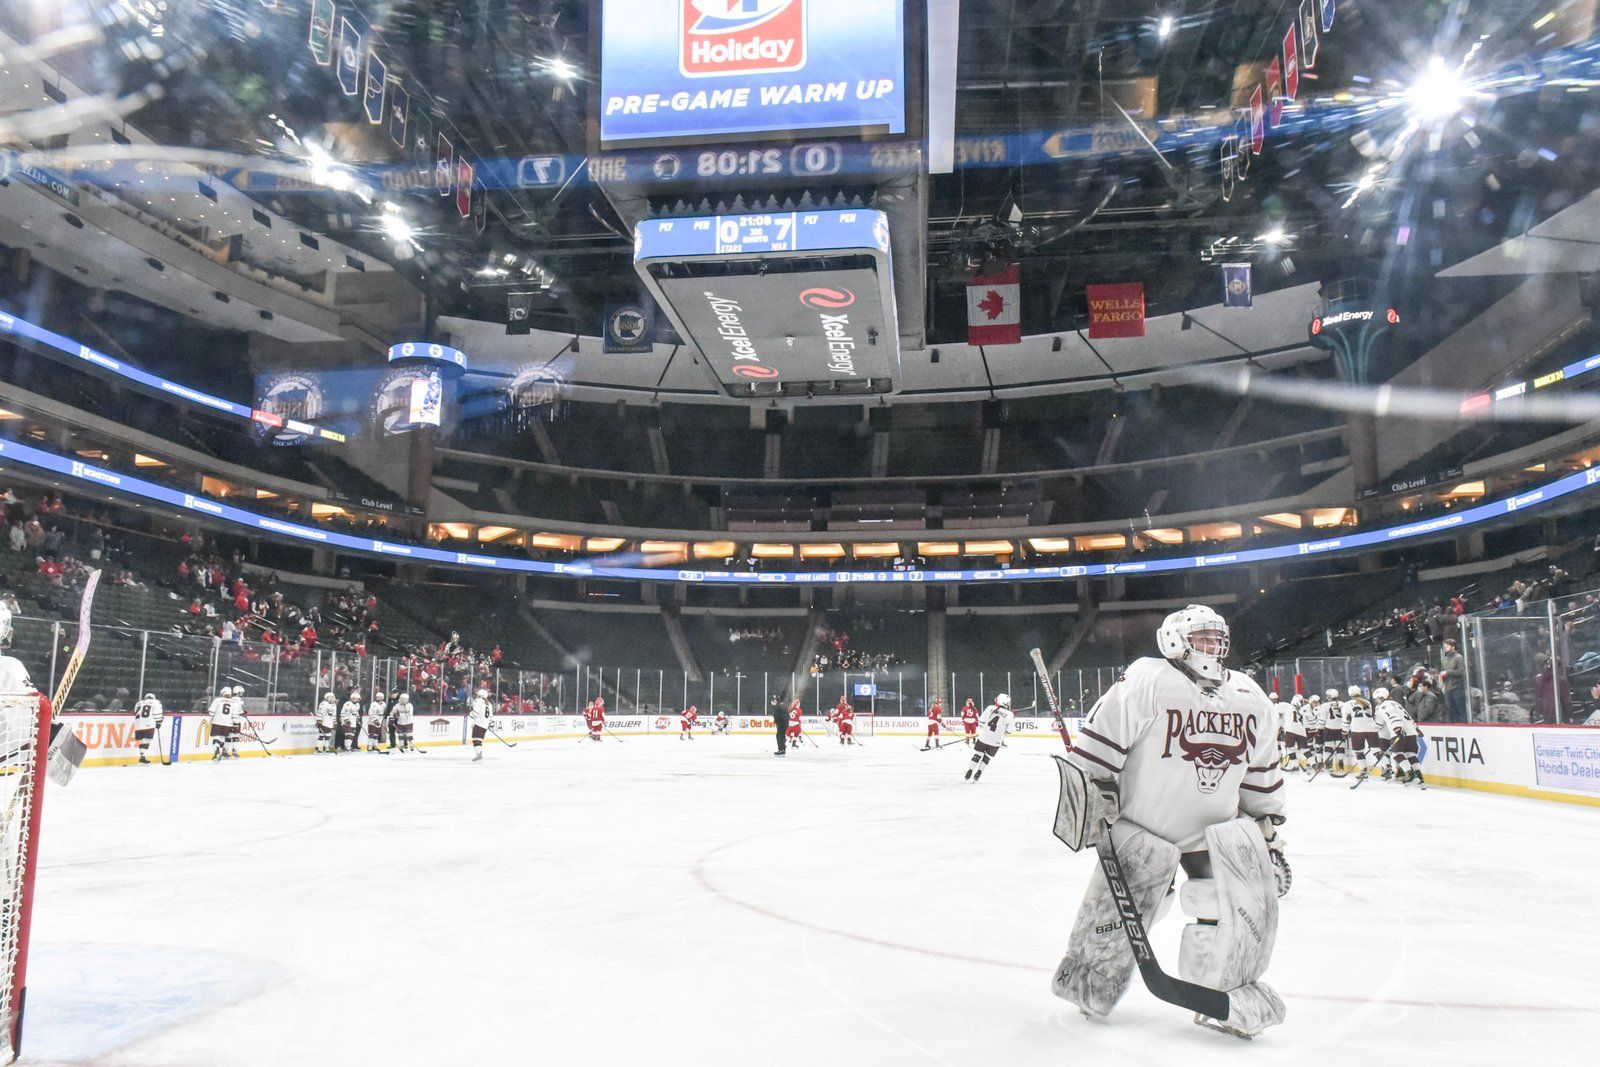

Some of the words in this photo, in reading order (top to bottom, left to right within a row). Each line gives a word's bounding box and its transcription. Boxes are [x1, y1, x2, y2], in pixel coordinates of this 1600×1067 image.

[691, 36, 795, 65] Holiday
[605, 87, 751, 116] PRE-GAME
[760, 81, 846, 106] WARM
[856, 79, 895, 99] UP
[720, 220, 739, 244] 0
[739, 215, 772, 227] 21:08
[774, 218, 792, 241] 7
[720, 243, 743, 253] STARS
[1090, 299, 1141, 311] WELLS
[1093, 311, 1142, 323] FARGO
[1391, 481, 1408, 492] Club
[1409, 477, 1427, 489] Level
[361, 498, 376, 507] Club
[376, 501, 393, 511] Level
[221, 703, 231, 715] 6
[488, 717, 503, 732] RIA
[750, 719, 762, 728] Old
[862, 720, 891, 728] WELLS
[891, 720, 920, 728] FARGO
[988, 715, 1000, 732] 4
[1161, 708, 1258, 760] PACKERS
[1431, 736, 1486, 766] TRIA
[1536, 745, 1564, 758] Greater
[1564, 746, 1584, 759] Twin
[1538, 760, 1569, 776] Honda
[1103, 858, 1151, 961] BAUER
[1095, 913, 1144, 935] BAU
[1236, 906, 1262, 944] BAUER
